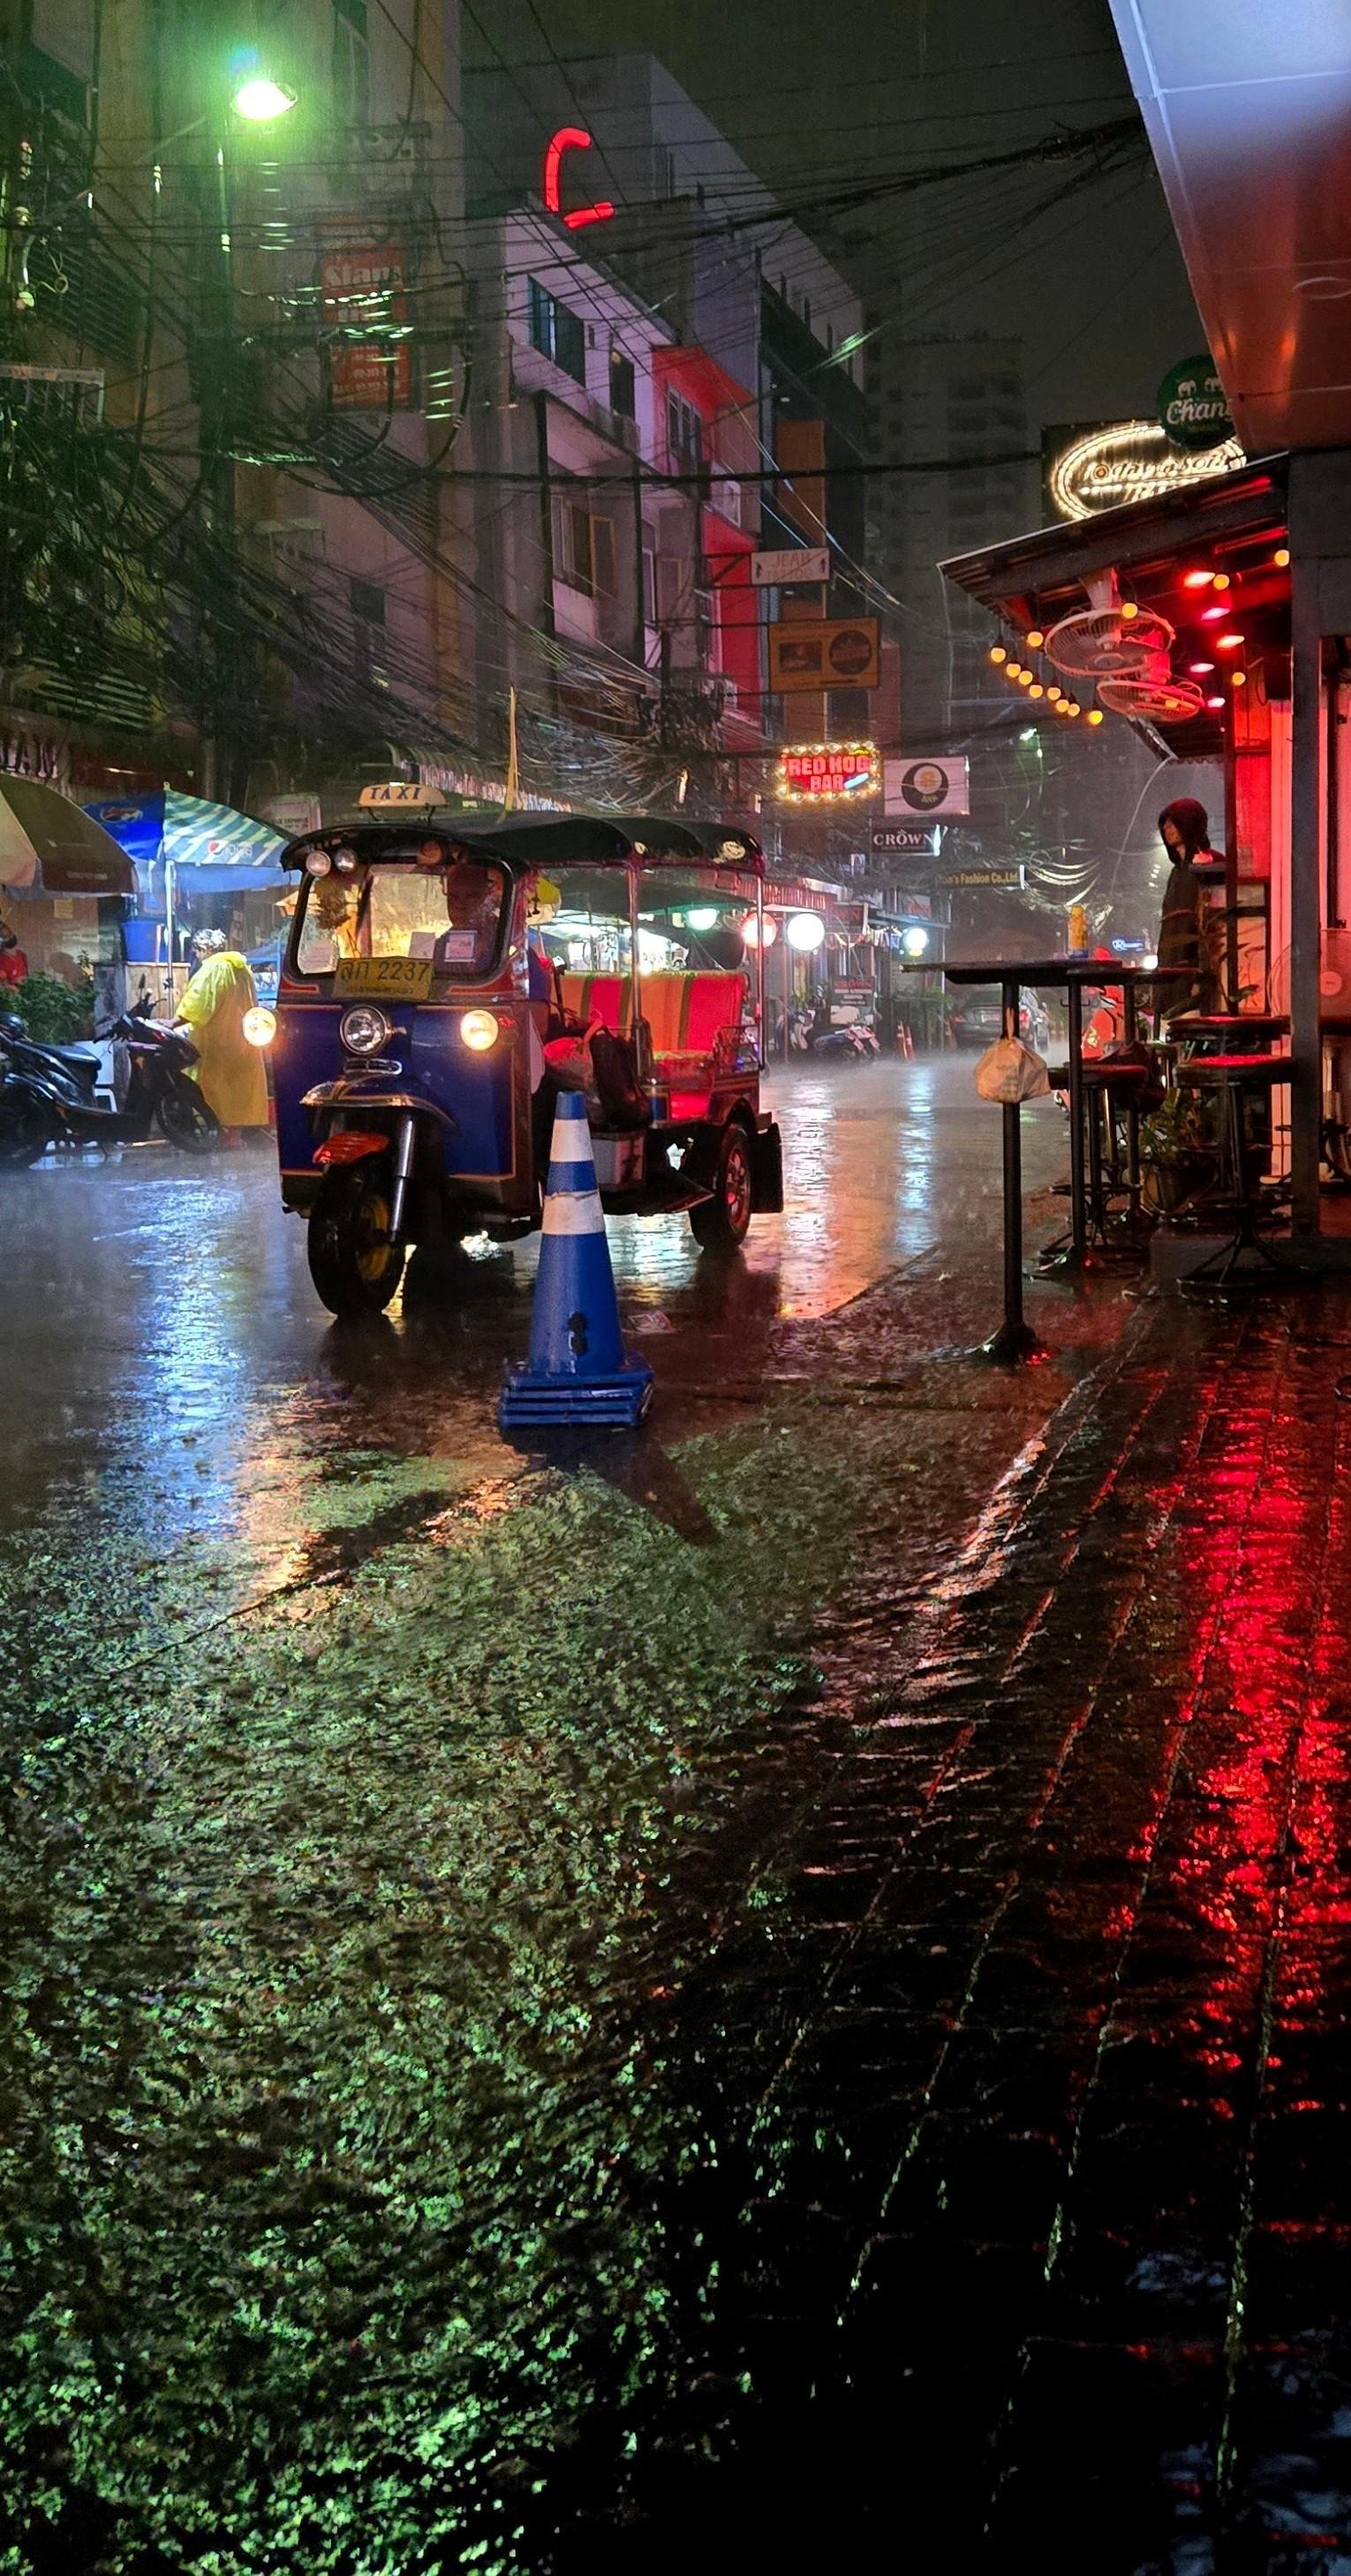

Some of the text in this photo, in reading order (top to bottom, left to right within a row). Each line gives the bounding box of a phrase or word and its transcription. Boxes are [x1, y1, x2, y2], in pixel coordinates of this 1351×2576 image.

[787, 757, 827, 777] RED
[810, 773, 845, 792] BAR
[369, 786, 422, 801] TAXI
[872, 832, 934, 846] CROWN
[376, 959, 431, 982] 2237
